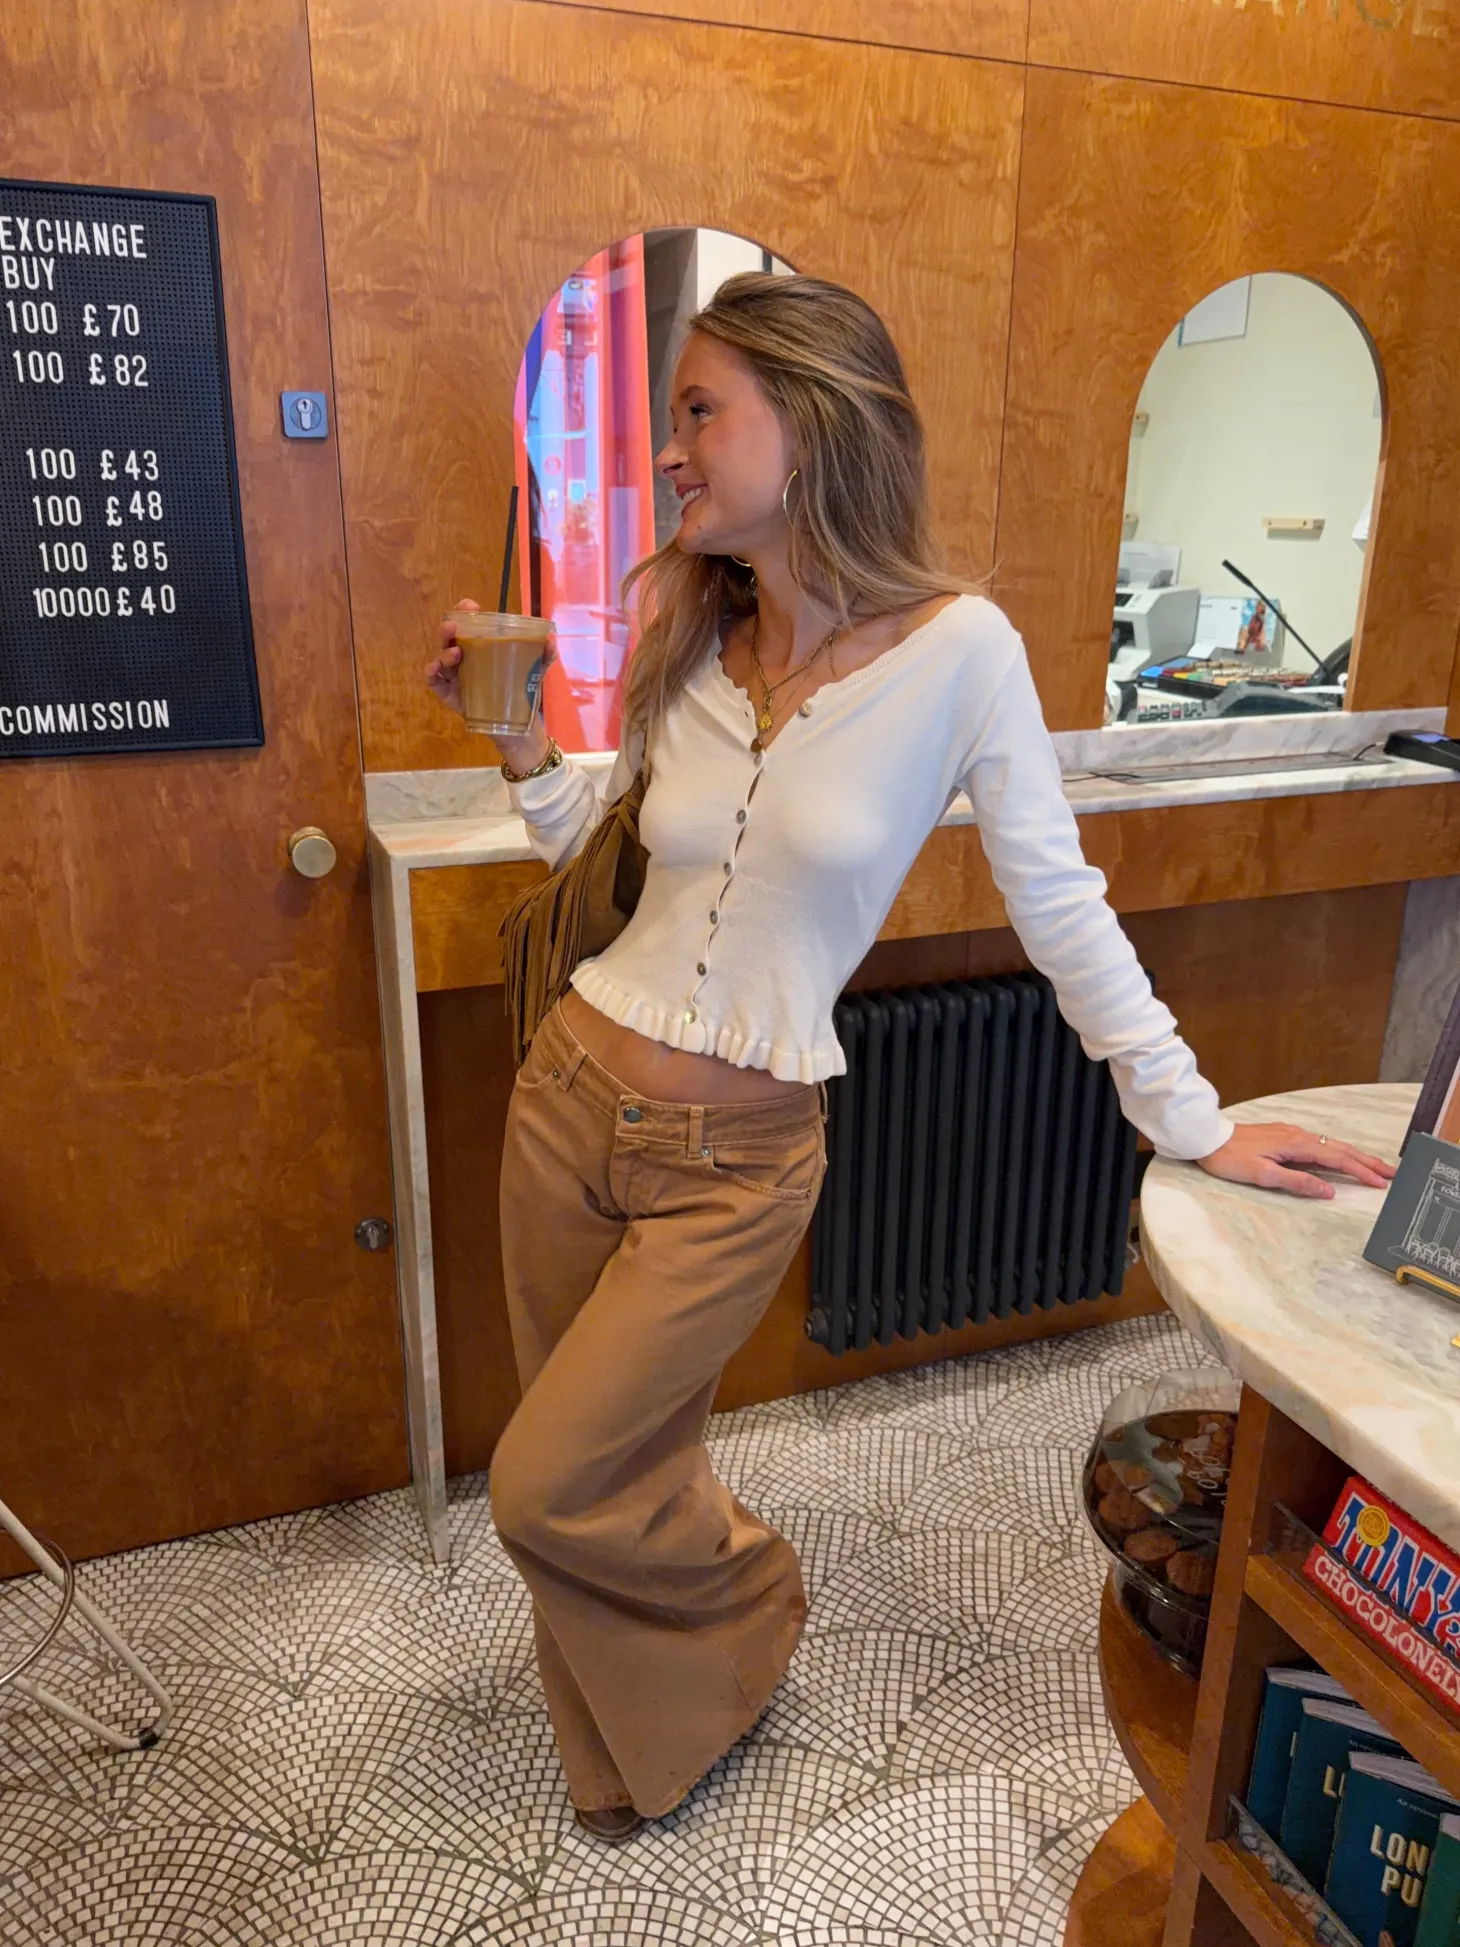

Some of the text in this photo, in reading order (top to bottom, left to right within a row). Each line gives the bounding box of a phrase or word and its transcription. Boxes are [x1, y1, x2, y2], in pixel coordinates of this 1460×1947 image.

[0, 215, 148, 259] EXCHANGE
[1, 254, 55, 291] BUY
[5, 299, 58, 335] 100
[12, 349, 64, 384] 100
[25, 447, 77, 480] 100
[32, 495, 82, 527] 100
[38, 541, 88, 573] 100
[0, 699, 170, 736] COMMISSION
